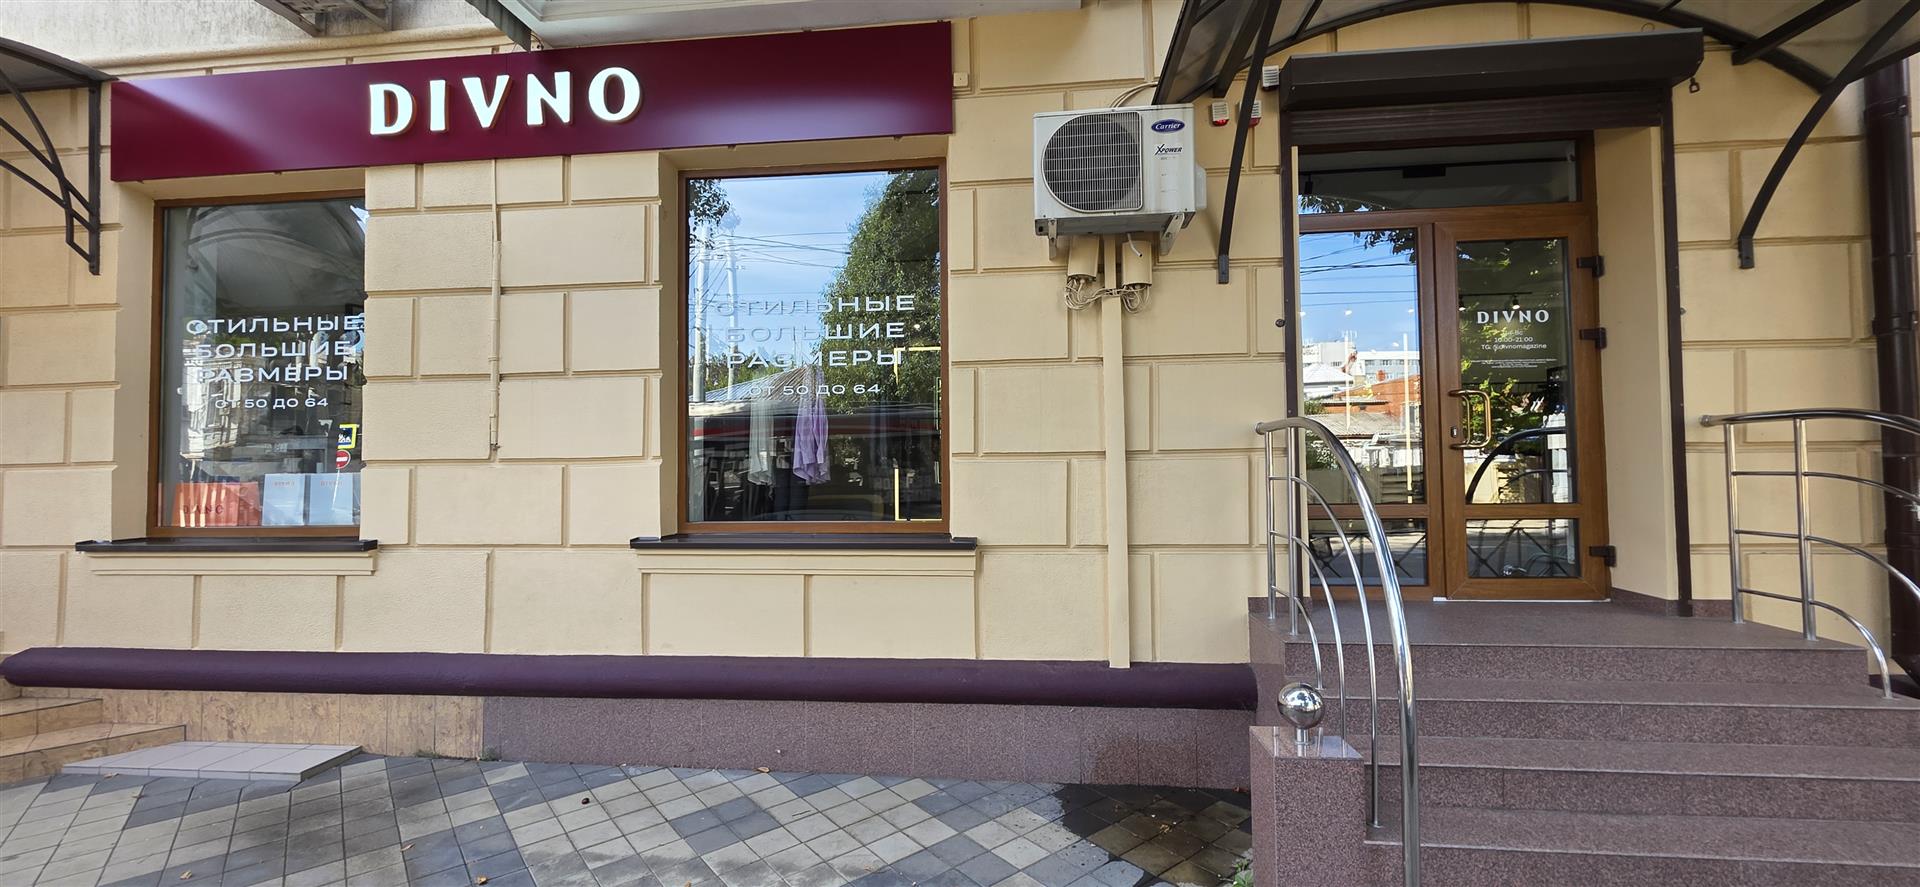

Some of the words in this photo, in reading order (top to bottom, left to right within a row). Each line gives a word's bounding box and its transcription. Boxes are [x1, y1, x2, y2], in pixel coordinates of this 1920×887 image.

[368, 66, 642, 137] DIVNO
[716, 295, 916, 317] СТИЛЬНЫЕ
[186, 315, 362, 335] СТИЛЬНЫЕ
[1476, 310, 1549, 324] DIVNO
[725, 322, 906, 343] БОЛЬШИЕ
[194, 340, 353, 358] БОЛЬШИЕ
[726, 349, 904, 369] РАЗМЕРЫ
[197, 365, 349, 383] РАЗМЕРЫ
[749, 386, 776, 396] ОТ
[783, 385, 809, 395] 50
[816, 384, 846, 396] ДО
[853, 383, 881, 395] 64
[214, 399, 240, 409] ОТ
[244, 398, 268, 409] 50
[272, 397, 299, 410] ДО
[304, 397, 329, 408] 64
